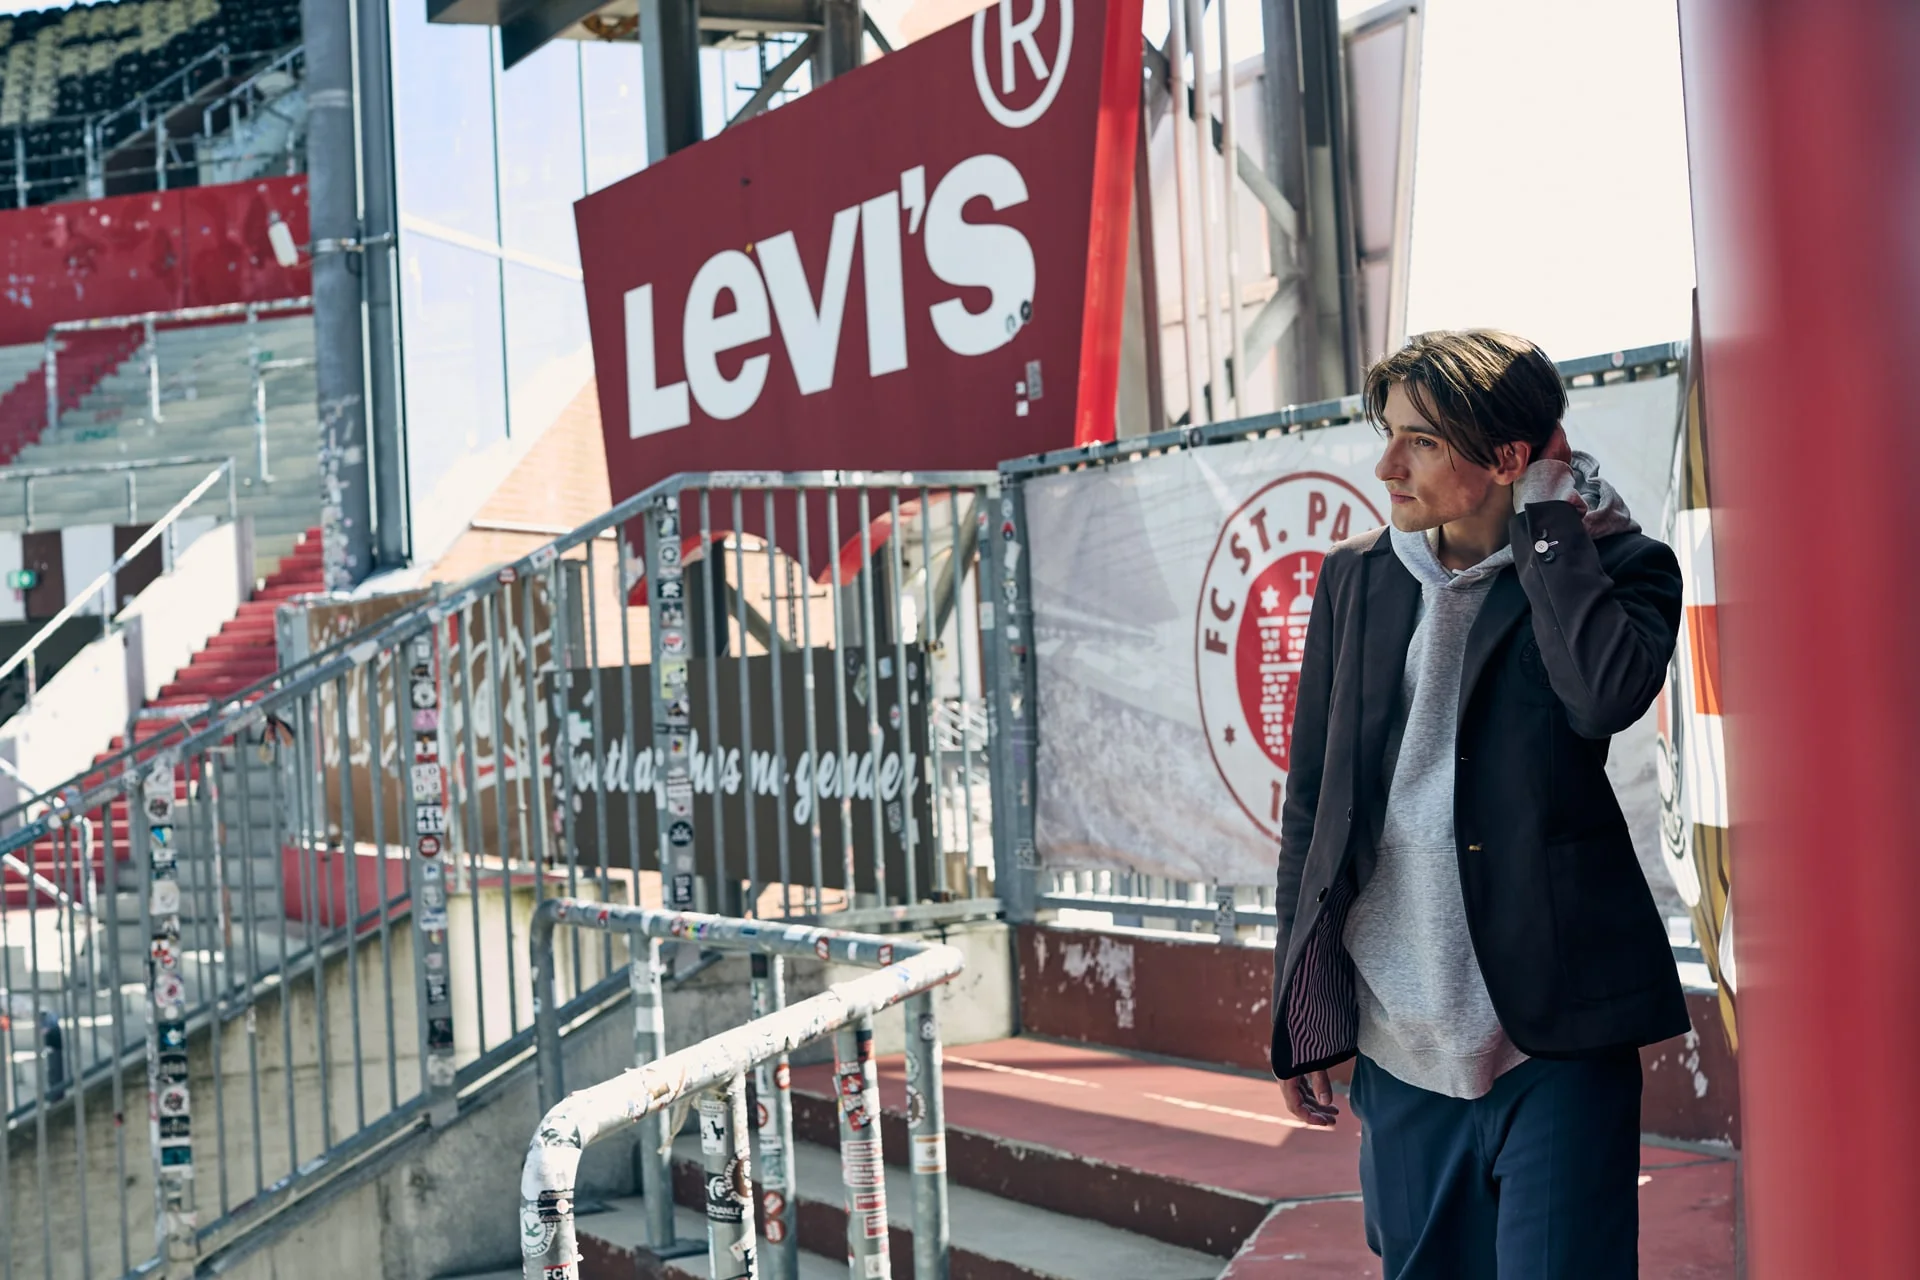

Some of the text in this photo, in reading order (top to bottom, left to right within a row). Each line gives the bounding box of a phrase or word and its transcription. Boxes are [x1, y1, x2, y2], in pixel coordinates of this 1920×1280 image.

[1204, 491, 1352, 656] FC ST. PA
